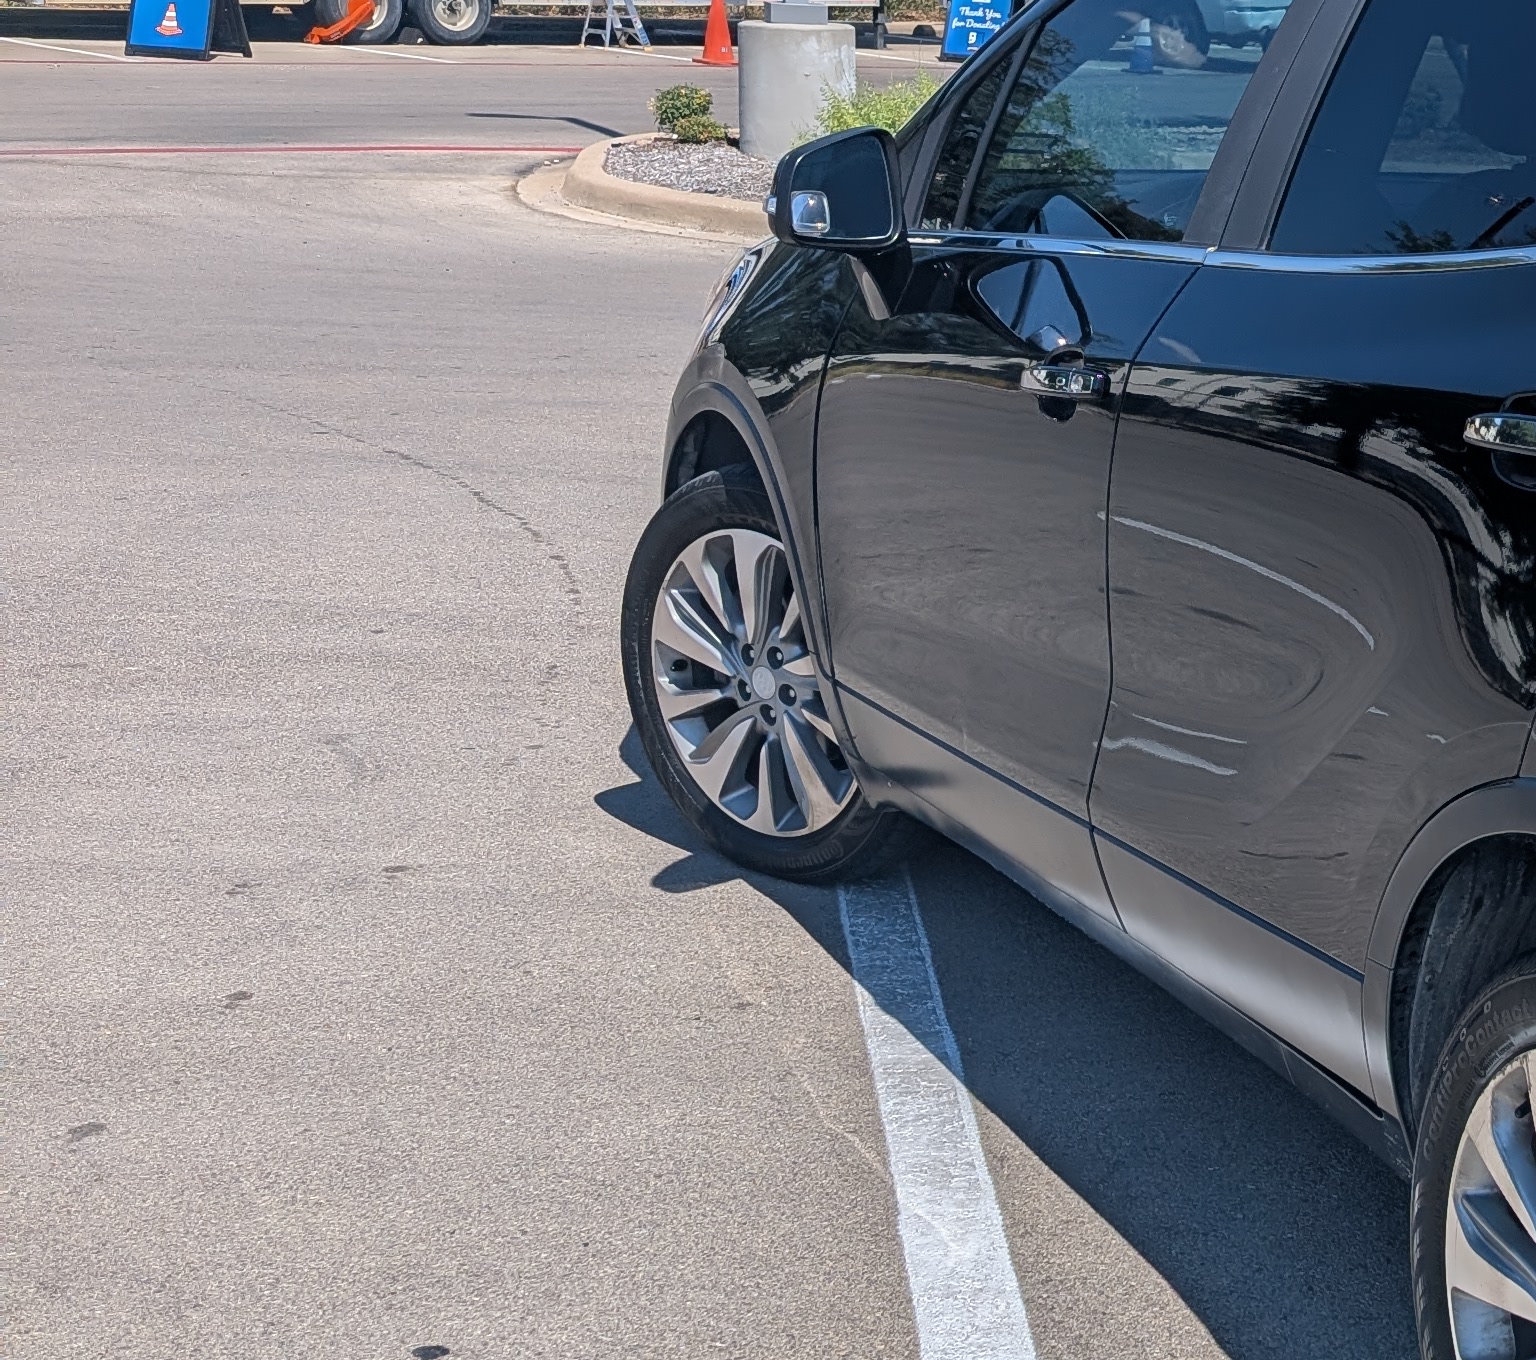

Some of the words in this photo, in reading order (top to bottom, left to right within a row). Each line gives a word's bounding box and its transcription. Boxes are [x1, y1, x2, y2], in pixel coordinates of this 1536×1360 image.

[959, 6, 984, 17] Thank
[985, 8, 1002, 21] You
[951, 17, 965, 29] for
